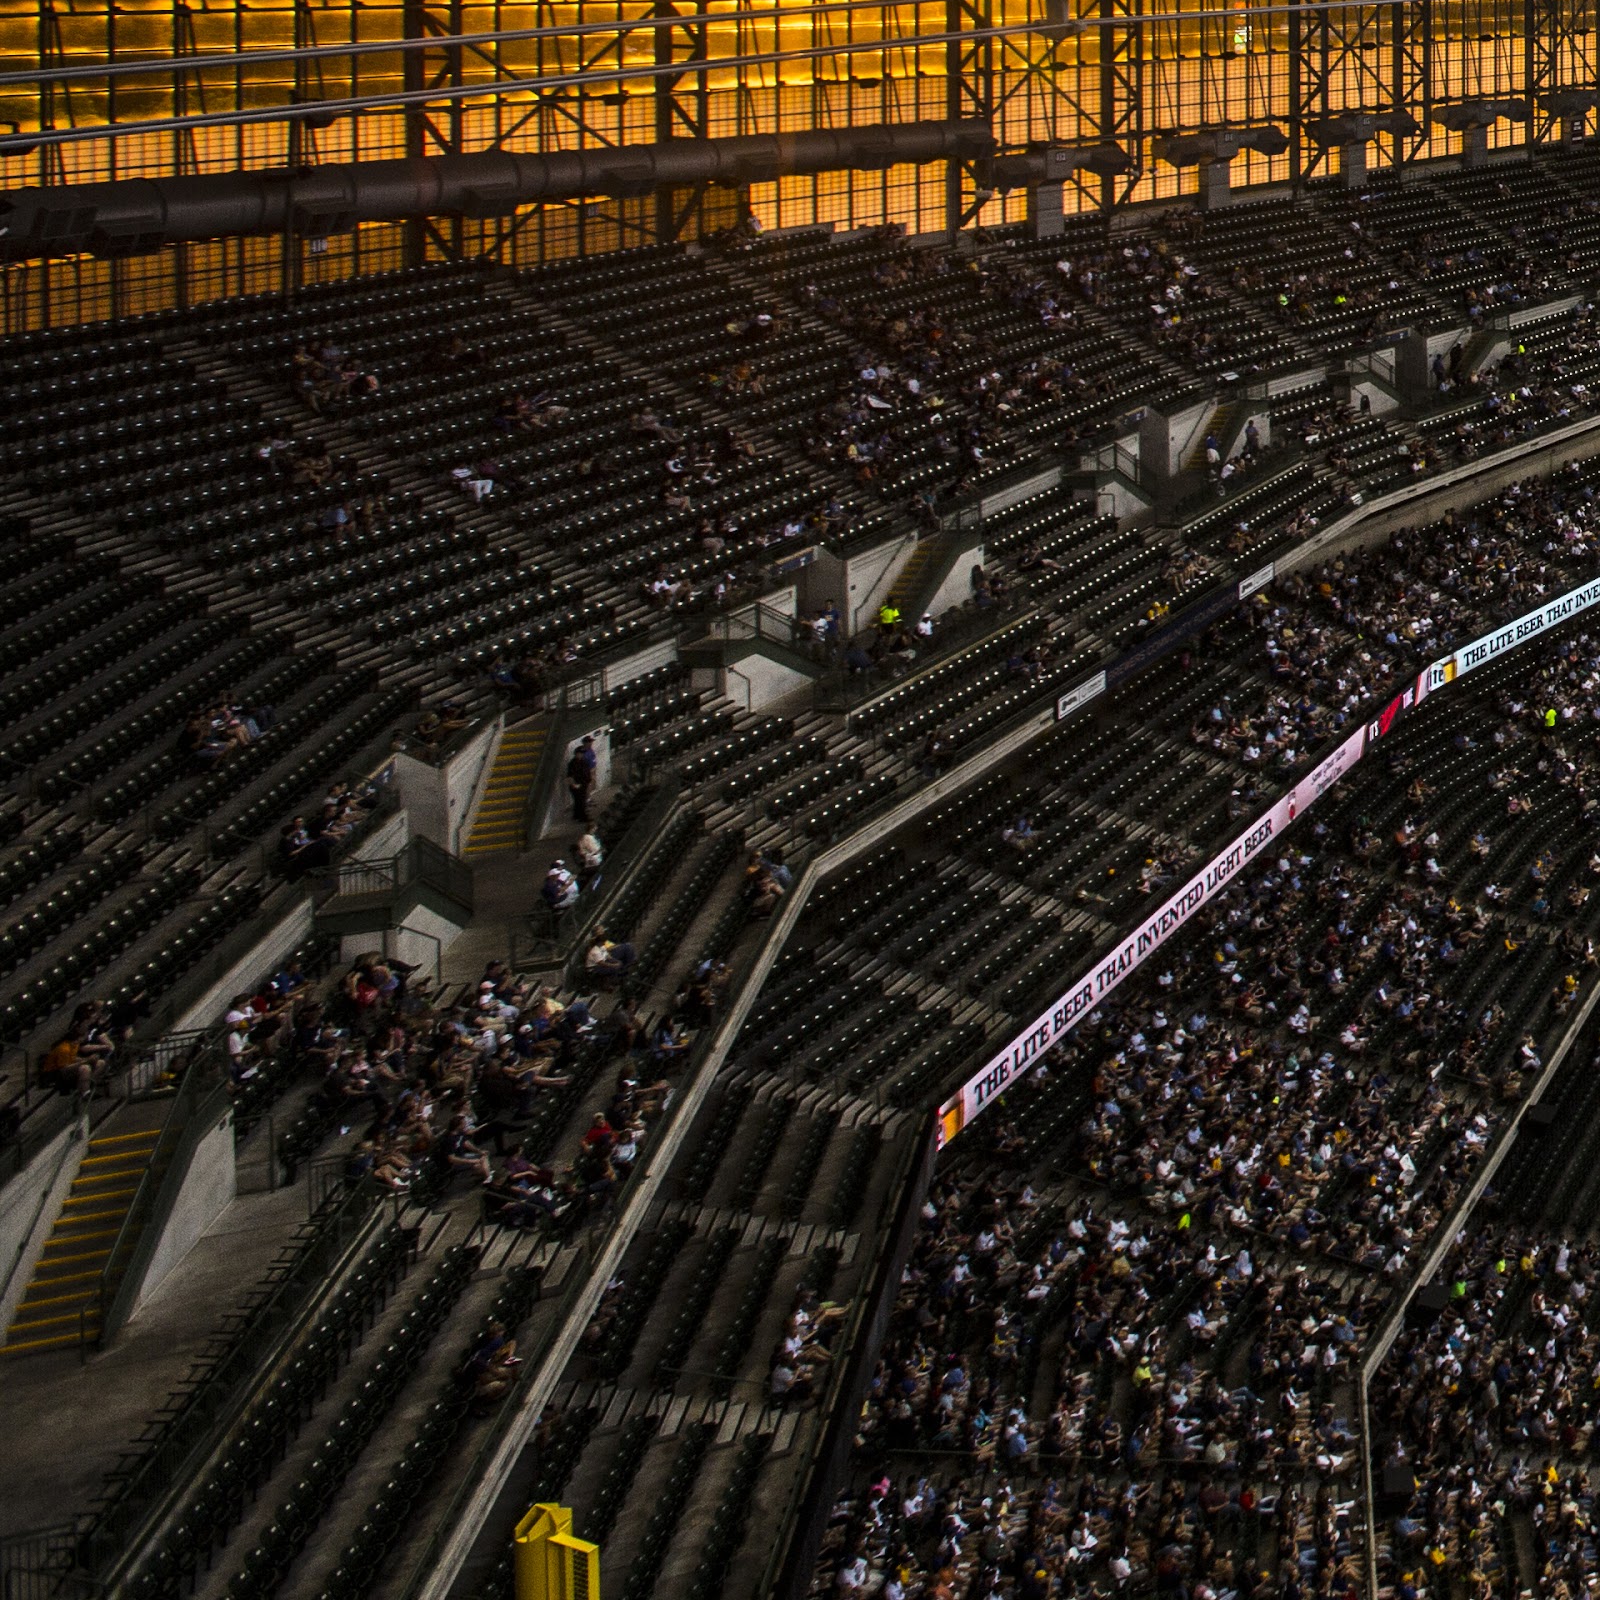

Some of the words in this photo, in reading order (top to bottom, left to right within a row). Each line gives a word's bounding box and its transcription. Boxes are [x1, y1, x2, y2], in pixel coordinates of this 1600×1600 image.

[1463, 643, 1487, 668] THE
[1489, 629, 1514, 654] LITE
[1516, 614, 1545, 639] BEER
[1546, 599, 1573, 623] THAT
[974, 1055, 1010, 1105] THE
[1013, 1021, 1050, 1071] LITE
[1053, 982, 1093, 1035] BEER
[1096, 945, 1135, 993] THAT
[1137, 885, 1204, 957] INVENTED
[1207, 846, 1243, 893] LIGHT
[1244, 818, 1273, 858] BEER
